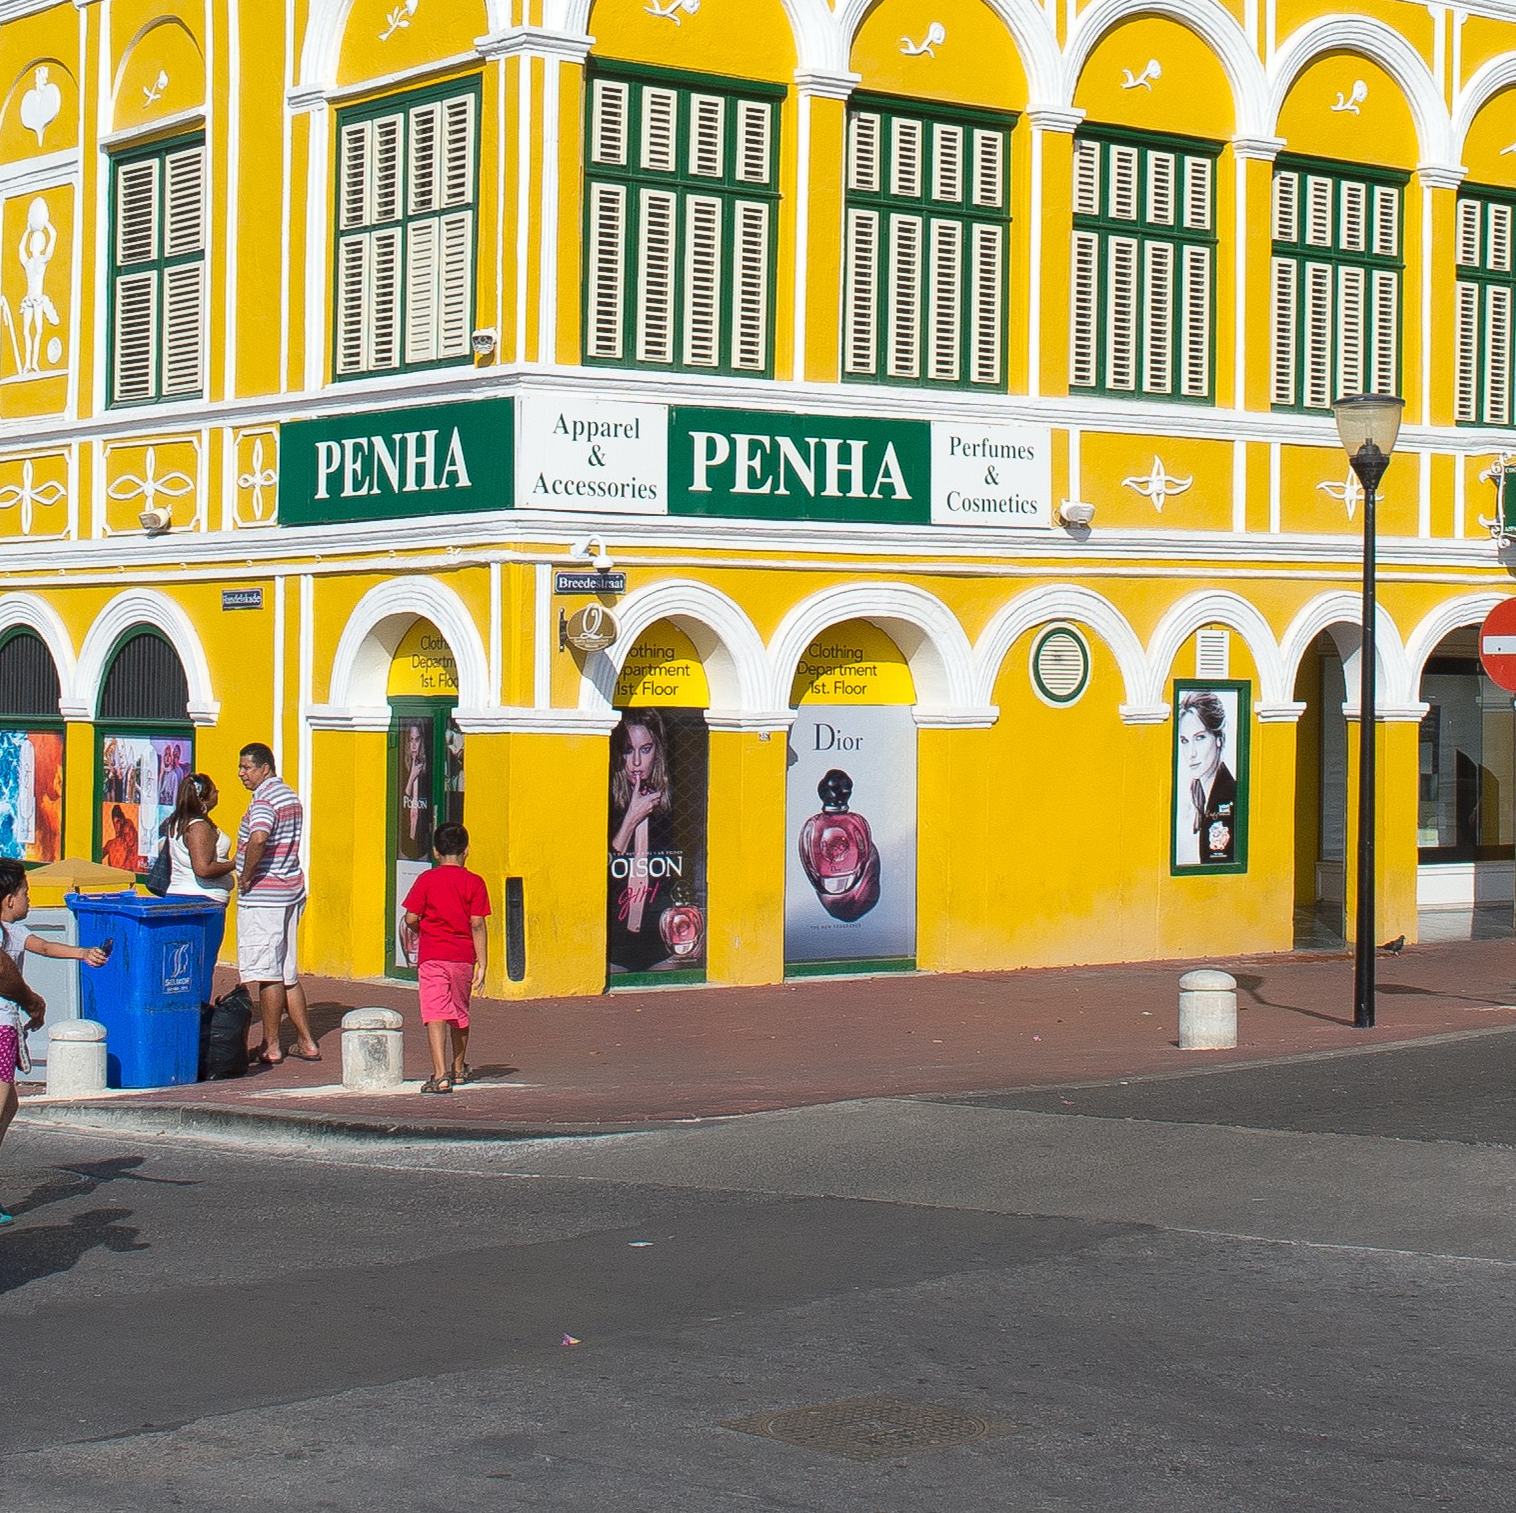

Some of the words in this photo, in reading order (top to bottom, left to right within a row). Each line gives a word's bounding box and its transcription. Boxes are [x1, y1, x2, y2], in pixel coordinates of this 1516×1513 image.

[552, 413, 640, 442] Apparel
[587, 444, 606, 467] &
[948, 435, 1035, 461] Perfumes
[314, 425, 473, 499] PENHA
[687, 431, 912, 500] PENHA
[984, 464, 1000, 485] &
[533, 472, 658, 499] Accessories
[947, 490, 1038, 515] Cosmetics
[558, 577, 624, 589] Breedestraat
[420, 634, 450, 650] Cloth
[627, 642, 675, 662] othing
[809, 642, 863, 663] Clothing
[411, 654, 455, 673] Departm
[618, 665, 691, 681] partment
[797, 661, 878, 680] Department
[420, 673, 436, 688] 1st.
[439, 673, 459, 688] Floo
[615, 681, 638, 695] 1st.
[642, 681, 679, 695] Floor
[808, 680, 830, 695] 1st.
[834, 680, 867, 695] Floor
[812, 723, 864, 752] Dior
[617, 881, 660, 921] girl
